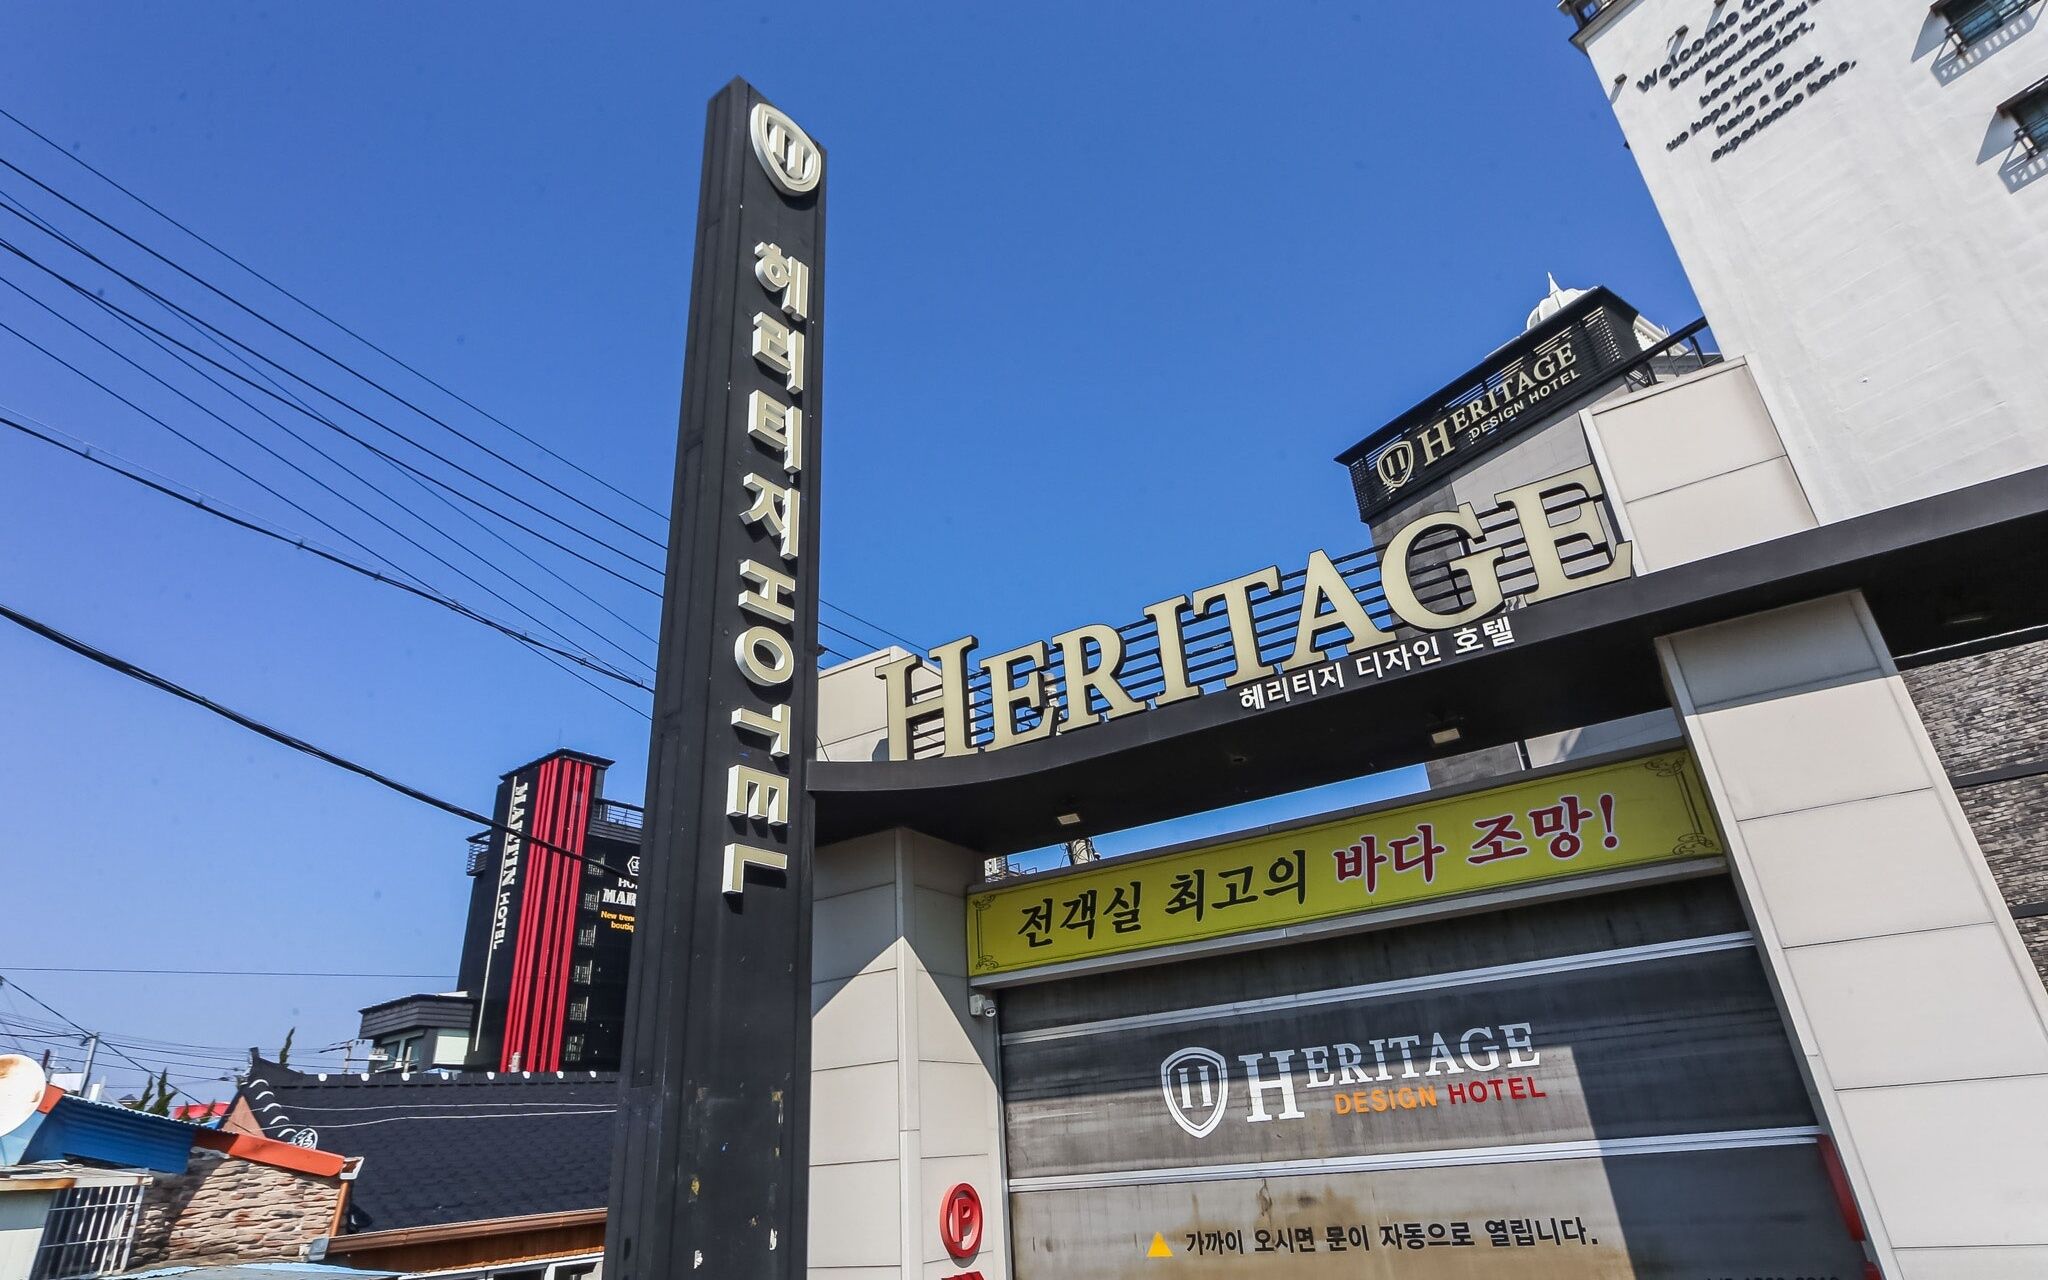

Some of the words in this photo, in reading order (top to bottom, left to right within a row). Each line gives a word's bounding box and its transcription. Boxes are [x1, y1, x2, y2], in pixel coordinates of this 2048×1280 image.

[1636, 11, 1739, 94] Welcome
[1668, 33, 1738, 91] boutique
[1705, 25, 1776, 85] Assuring
[1775, 2, 1808, 34] you
[1666, 131, 1689, 152] we
[1690, 101, 1731, 136] hope
[1732, 78, 1763, 108] you
[1764, 62, 1785, 81] to
[1698, 75, 1738, 109] best
[1710, 93, 1805, 163] experience
[1715, 105, 1756, 139] have
[1758, 94, 1771, 109] a
[1774, 56, 1825, 100] great
[1416, 342, 1578, 467] HERITAGE
[1470, 402, 1525, 440] DESIGN
[1528, 367, 1582, 405] HOTEL
[875, 464, 1634, 764] HERITAGE
[1238, 661, 1345, 711] 헤리티지
[1355, 635, 1443, 679] 디자인
[1453, 615, 1516, 656] 호텔
[722, 558, 796, 895] HOTEL
[1018, 881, 1142, 948] 전객실
[1164, 849, 1306, 922] 최고의
[1333, 823, 1446, 894] 바다
[1466, 793, 1618, 866] 조망!
[493, 892, 511, 951] HOTEL
[600, 910, 618, 920] New
[1238, 1022, 1541, 1123] HERITAGE
[1333, 1085, 1438, 1116] DESIGN
[1447, 1076, 1547, 1105] HOTEL
[1185, 1230, 1245, 1256] 가까이
[1254, 1226, 1316, 1253] 오시면
[1325, 1224, 1370, 1252] 문이
[1380, 1221, 1475, 1250] 자동으로
[1484, 1216, 1600, 1248] 열립니다.
